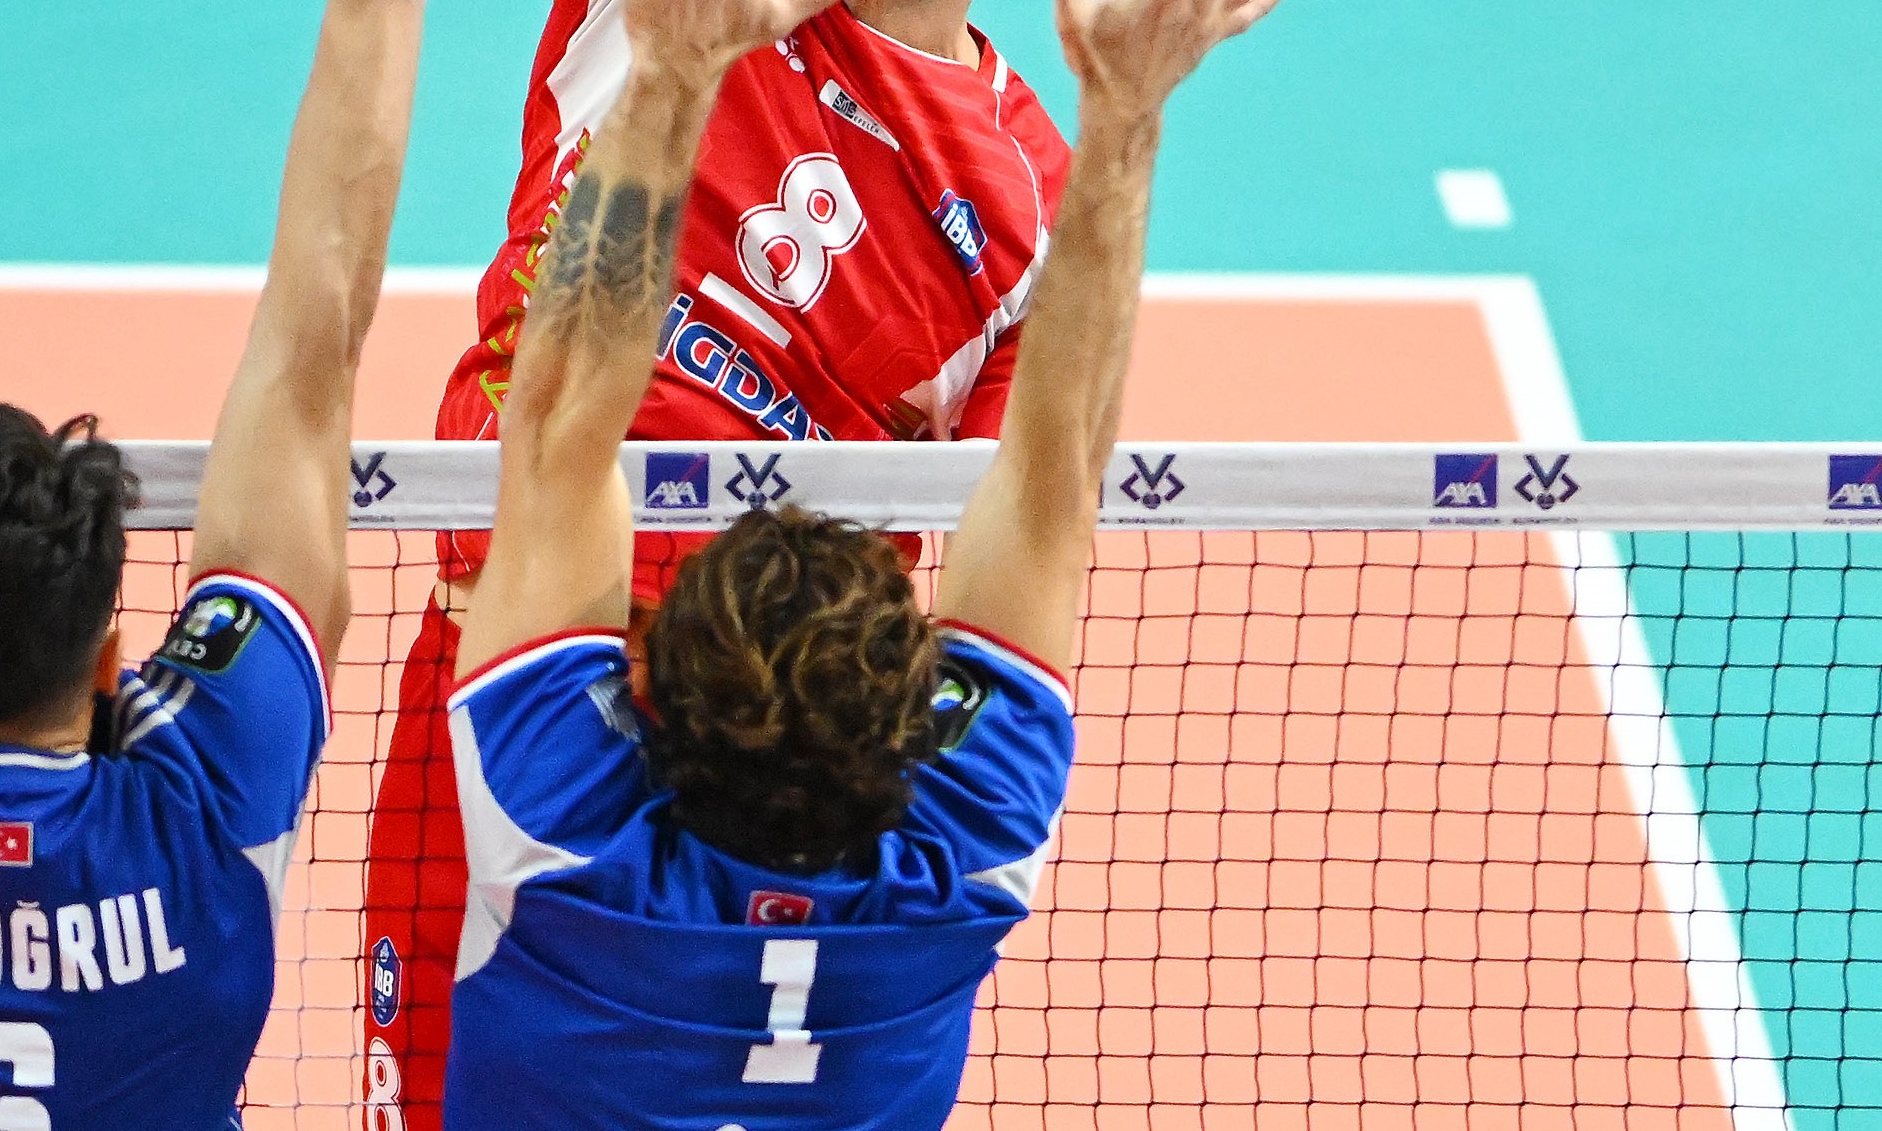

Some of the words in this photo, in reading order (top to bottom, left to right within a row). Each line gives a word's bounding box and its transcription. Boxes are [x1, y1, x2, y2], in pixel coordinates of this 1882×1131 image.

[735, 152, 867, 312] 8
[654, 293, 834, 441] İGDA
[646, 481, 698, 505] AXA
[1434, 481, 1487, 506] AXA
[742, 938, 822, 1084] 1
[367, 1036, 408, 1131] 8
